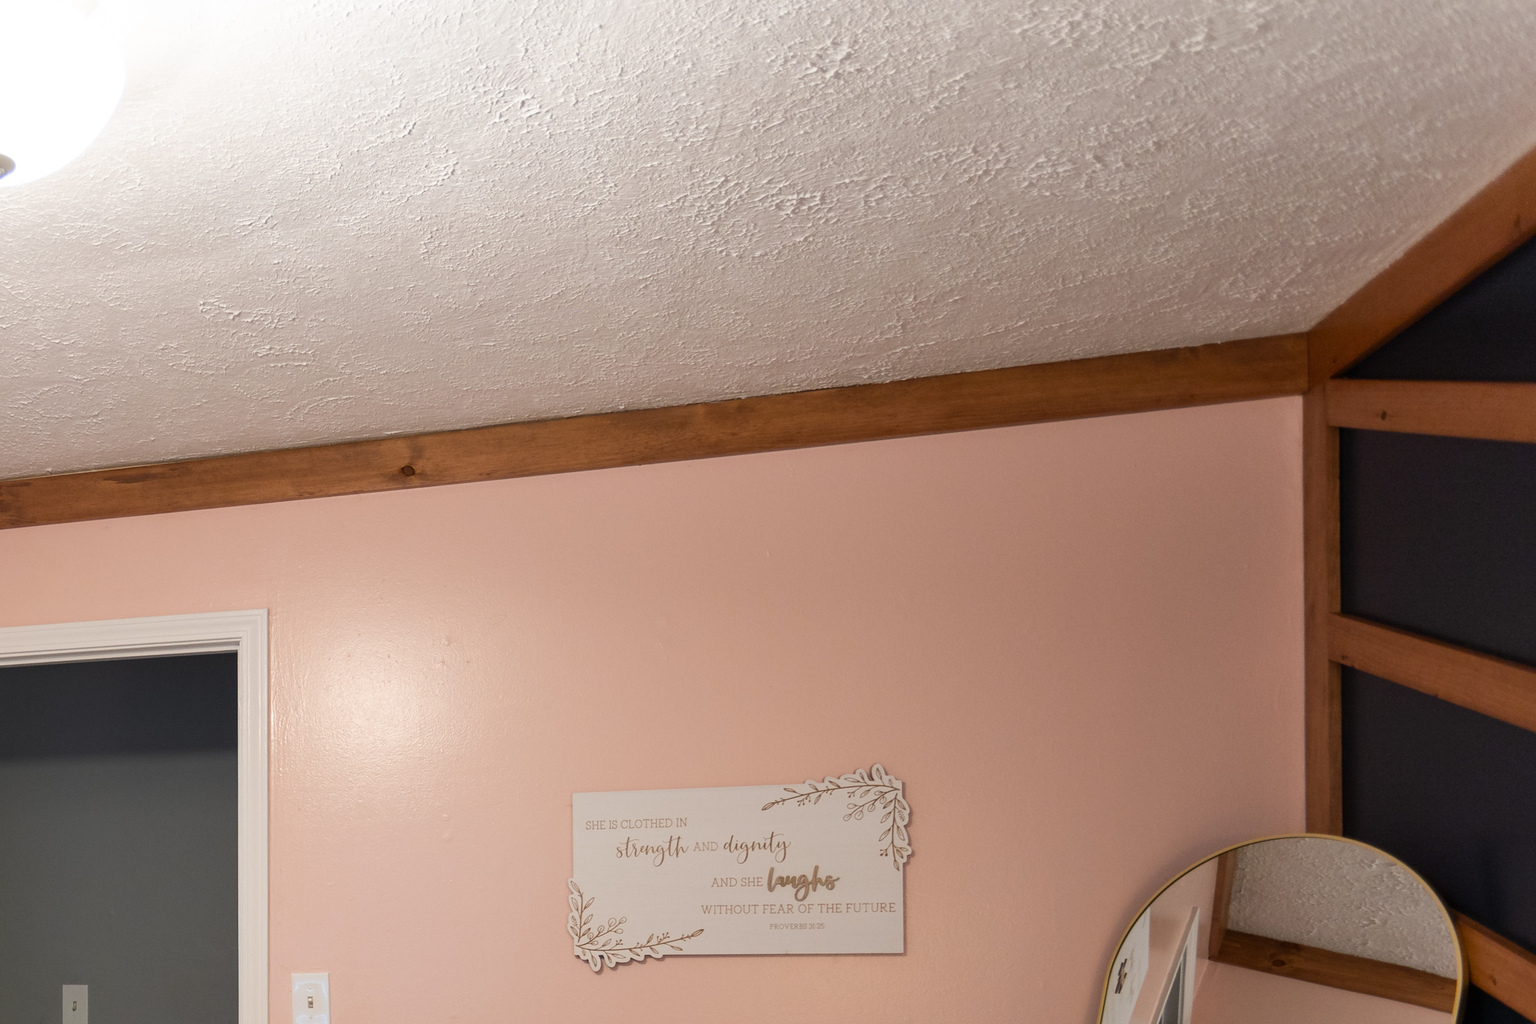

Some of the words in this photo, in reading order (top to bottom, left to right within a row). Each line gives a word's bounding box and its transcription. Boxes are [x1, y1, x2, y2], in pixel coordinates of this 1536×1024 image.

[585, 820, 606, 830] SHE
[608, 819, 618, 830] IS
[620, 818, 674, 830] CLOTHED
[676, 817, 688, 828] IN
[615, 835, 689, 867] strength
[693, 841, 719, 852] AND
[723, 831, 792, 864] dignity
[711, 877, 738, 888] AND
[740, 876, 763, 887] SHE
[767, 865, 840, 902] laughs
[701, 904, 759, 915] WITHOUT
[762, 904, 795, 914] FEAR
[797, 903, 814, 914] OF
[817, 903, 843, 914] THE
[846, 902, 896, 913] FUTURE
[769, 923, 808, 931] PROVERBS
